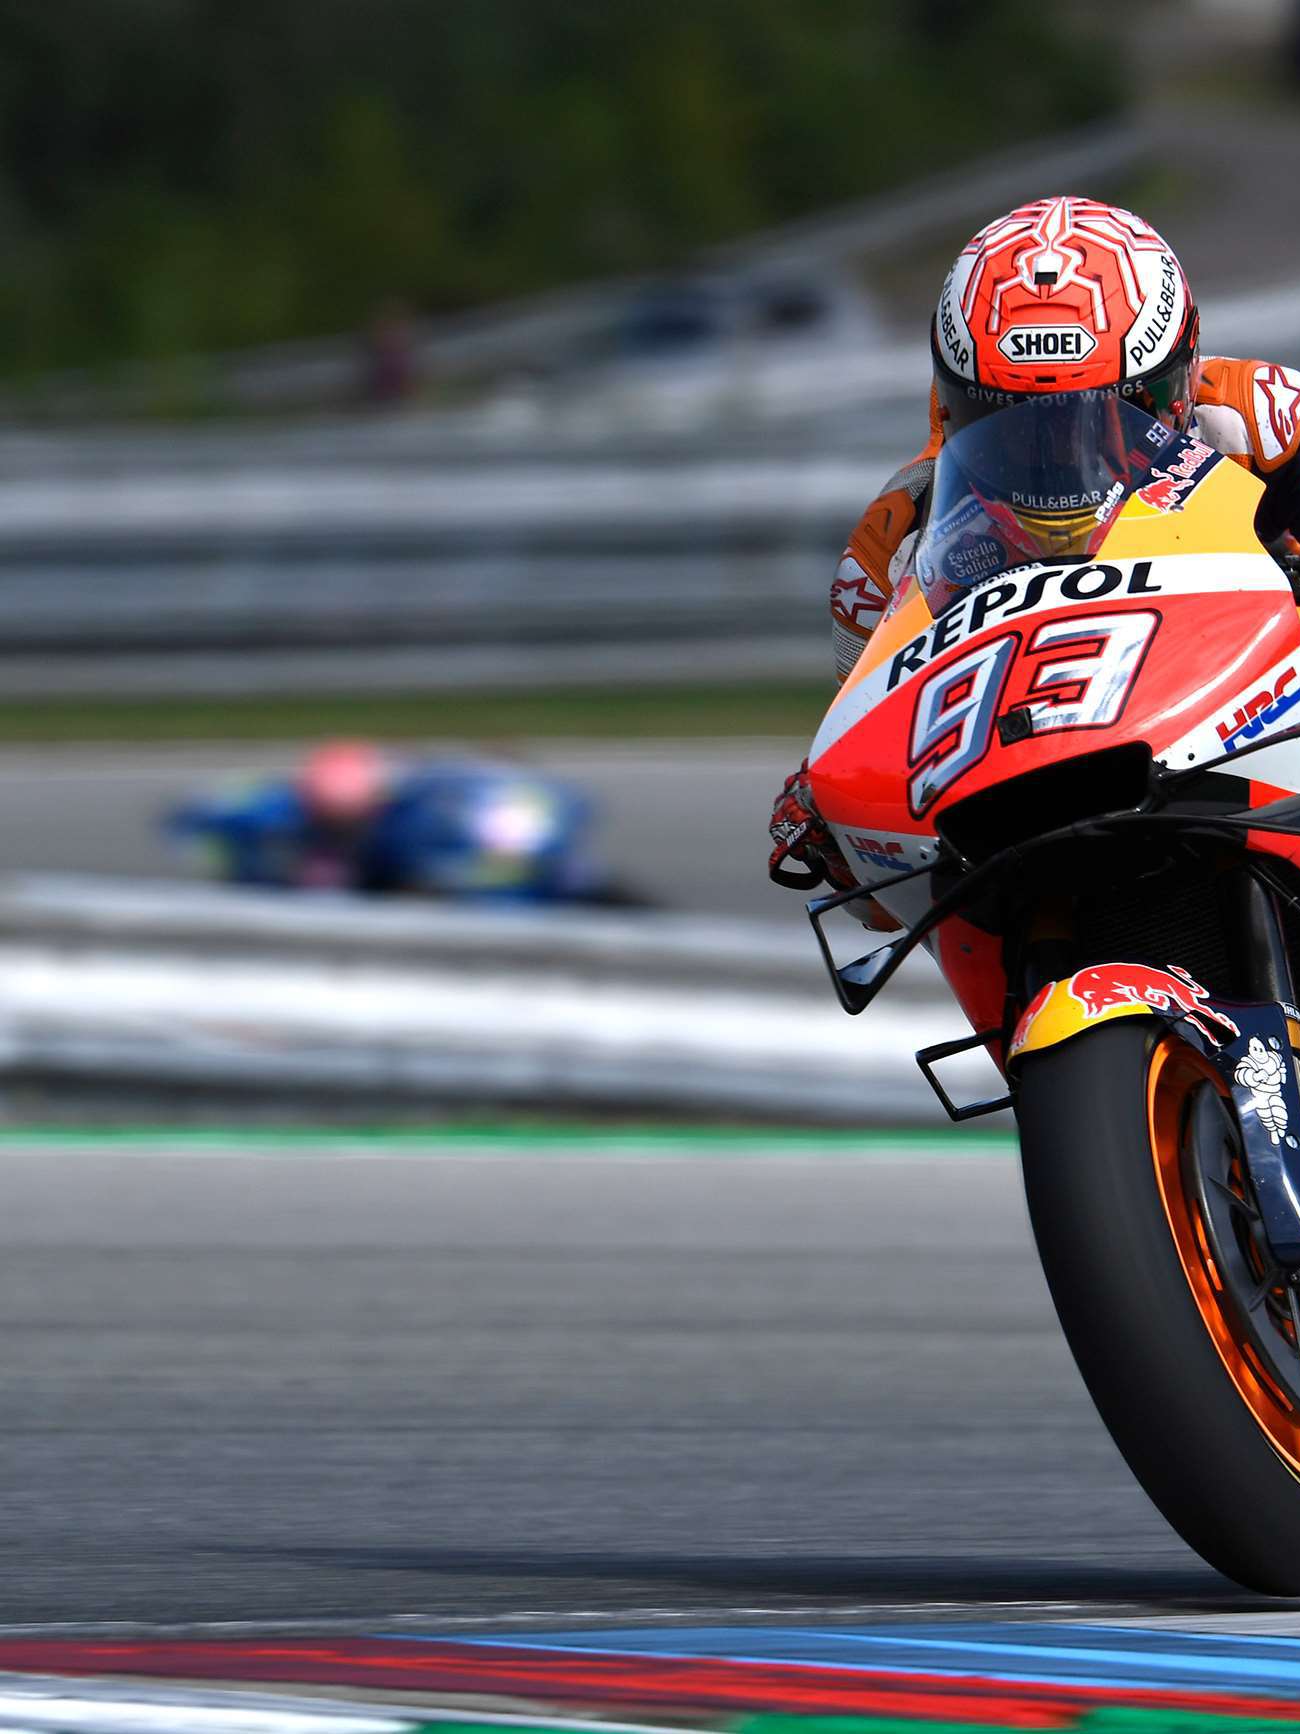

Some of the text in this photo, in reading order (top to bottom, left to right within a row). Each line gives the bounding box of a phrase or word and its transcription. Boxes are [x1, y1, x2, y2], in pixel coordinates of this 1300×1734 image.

[1011, 332, 1082, 355] SHOEI
[1129, 255, 1177, 367] PULL&BEAR
[967, 386, 1014, 407] GIVES
[1080, 379, 1145, 404] WINGS
[1011, 490, 1102, 510] PULL&BEAR
[885, 561, 1164, 693] REPSOL
[908, 609, 1165, 820] 93
